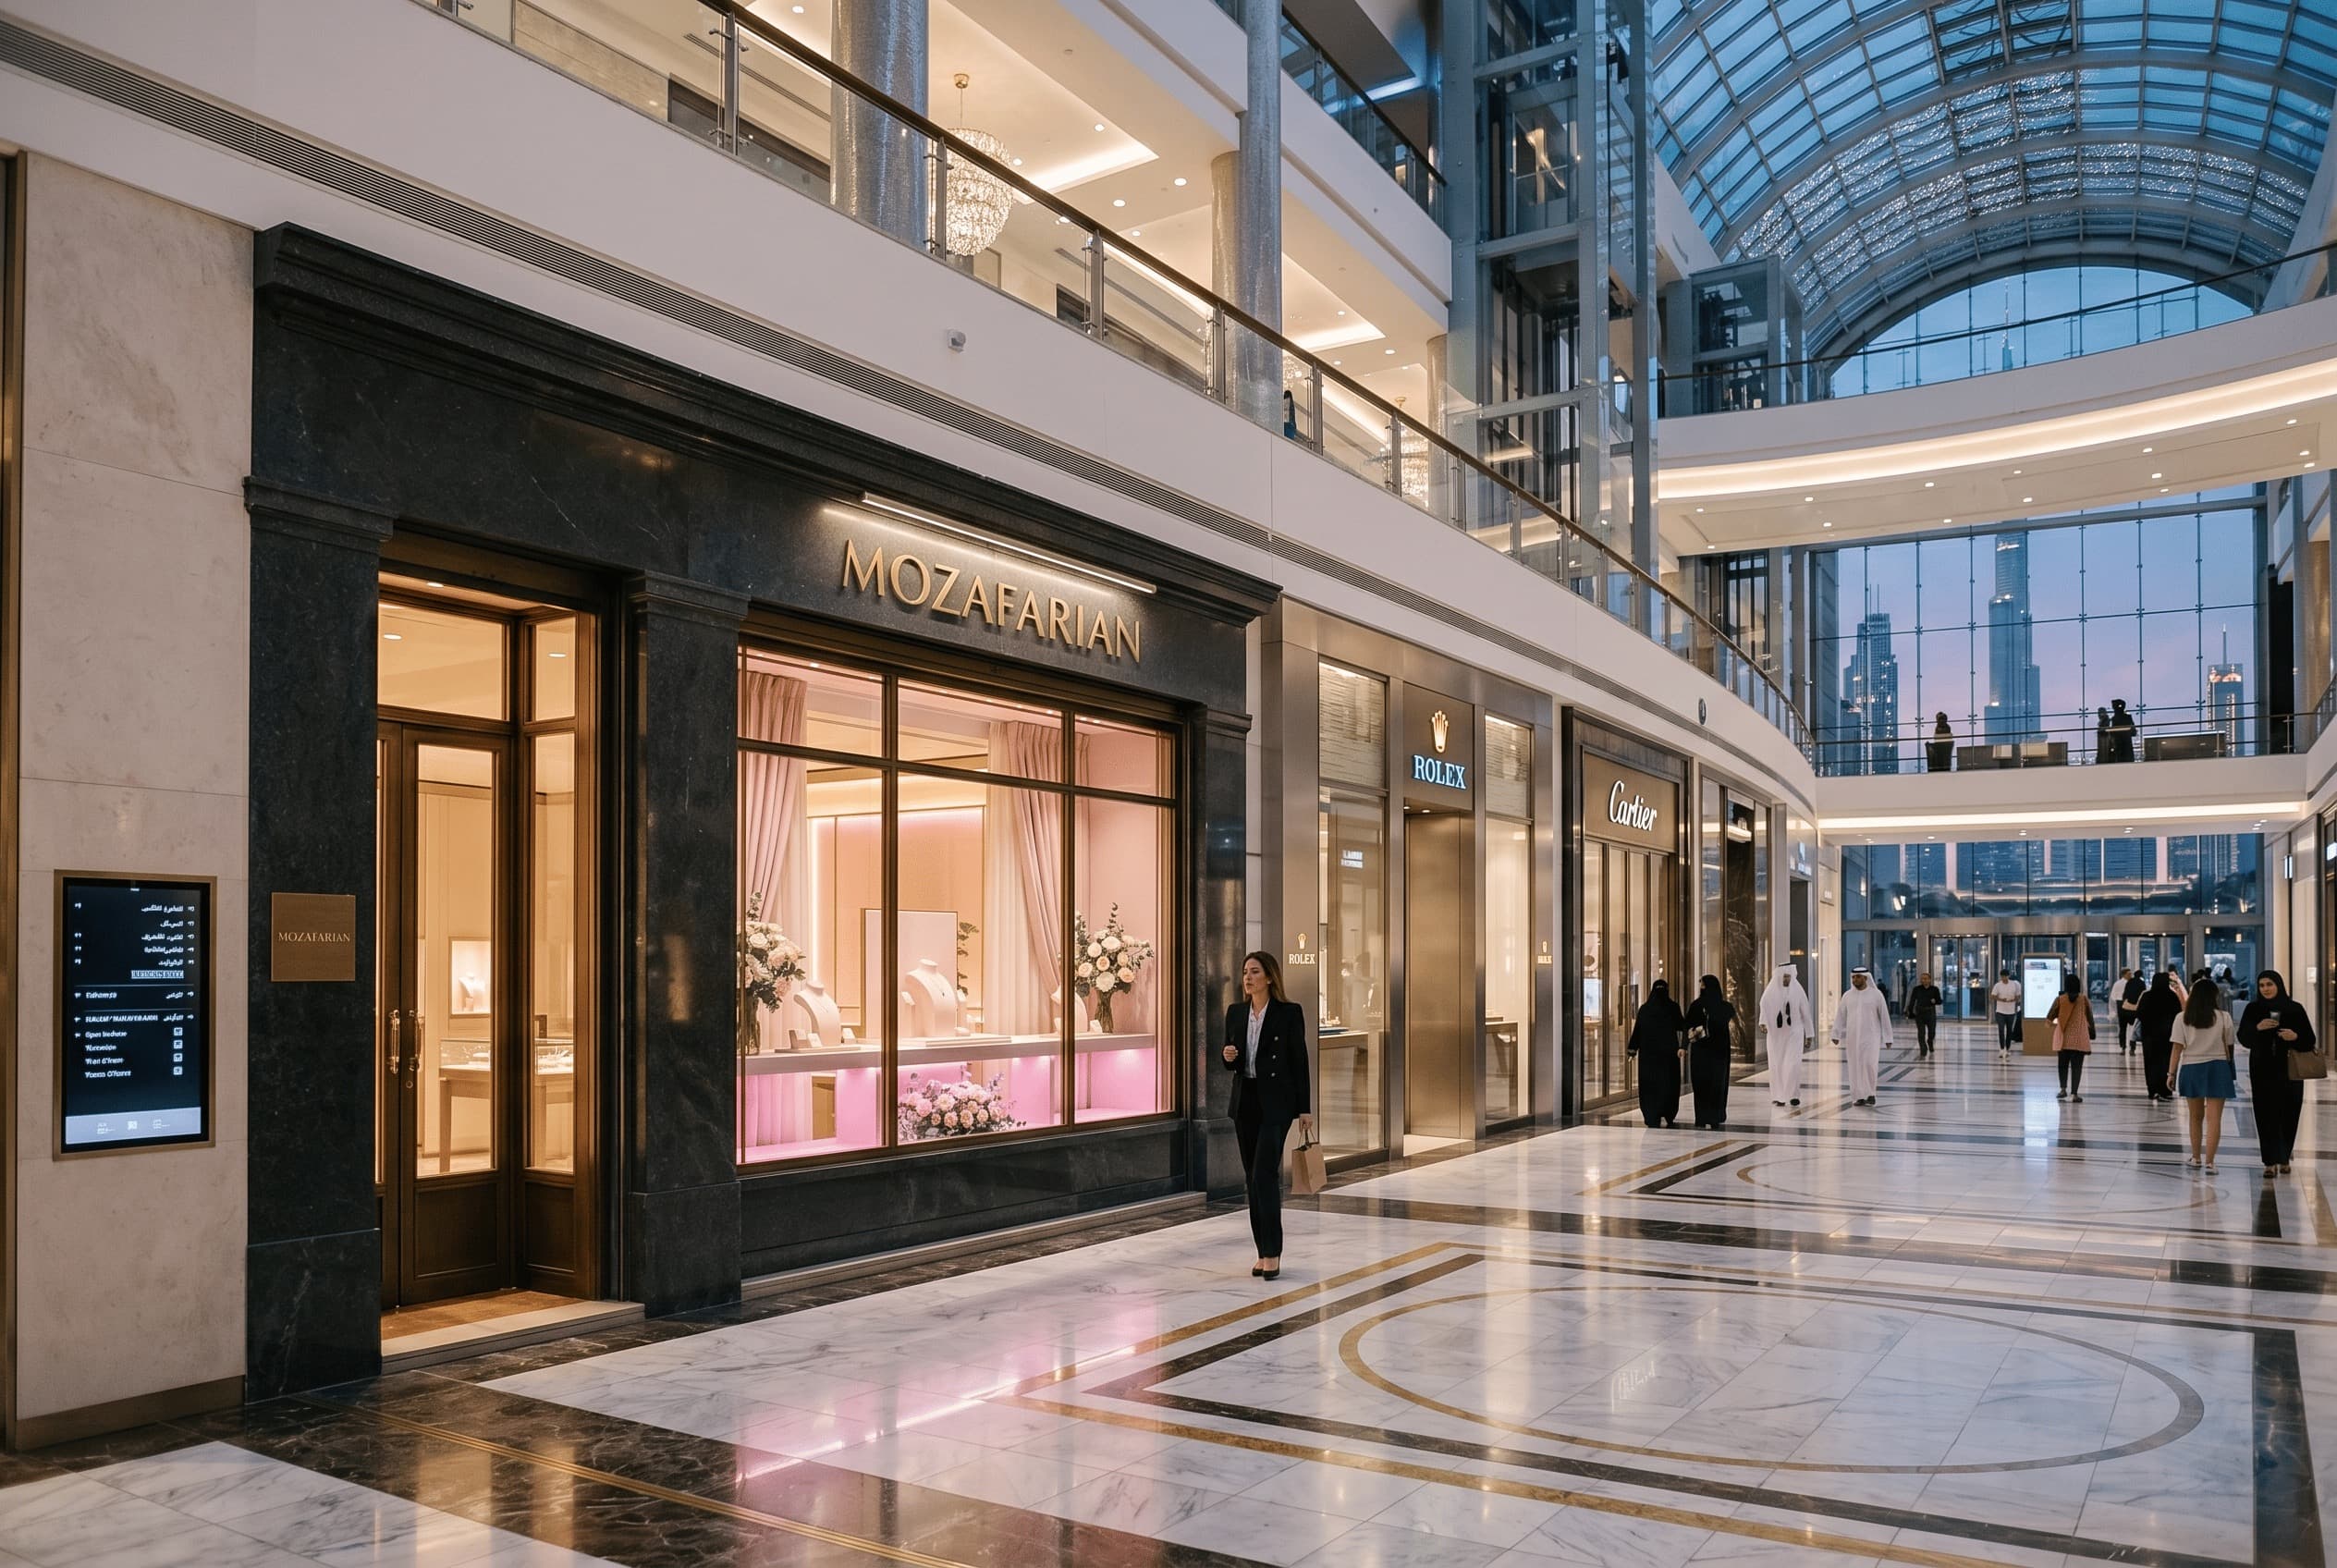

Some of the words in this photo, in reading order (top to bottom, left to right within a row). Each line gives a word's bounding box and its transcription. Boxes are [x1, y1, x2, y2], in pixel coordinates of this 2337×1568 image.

[842, 539, 1141, 664] MOZAFARIAN
[1413, 754, 1467, 790] ROLEX
[1609, 780, 1658, 832] Cartier
[277, 931, 350, 942] MOZAFARIAN
[1289, 953, 1315, 964] ROLEX
